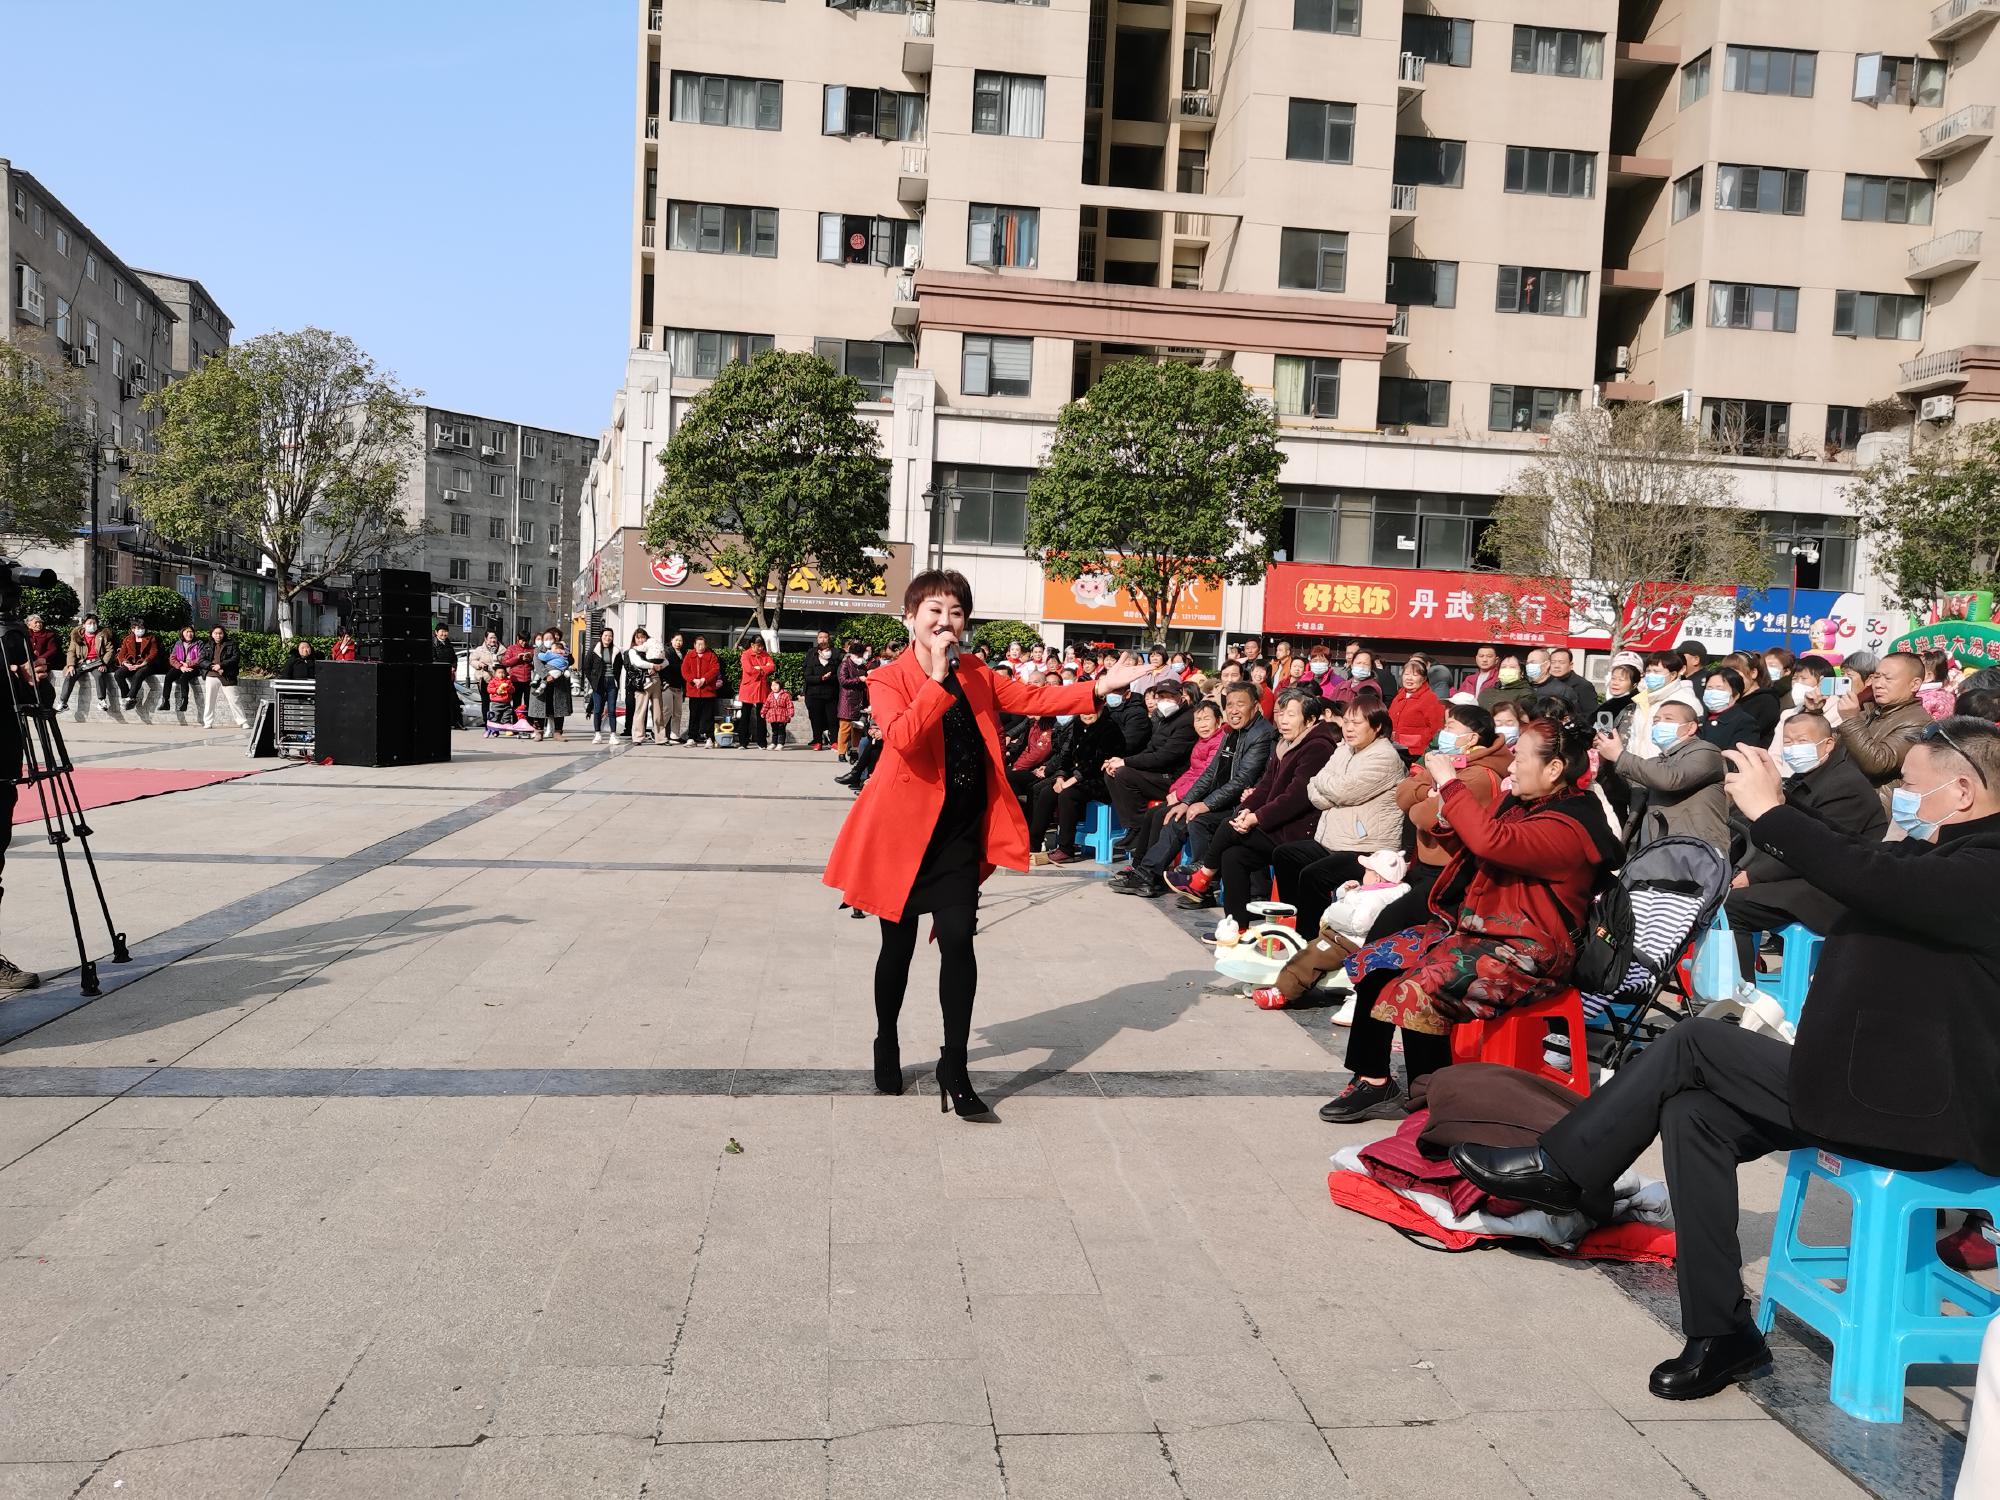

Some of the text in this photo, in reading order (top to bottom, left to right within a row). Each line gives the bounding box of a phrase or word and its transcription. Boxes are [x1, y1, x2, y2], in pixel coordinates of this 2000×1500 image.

[1303, 583, 1547, 625] 好想你 丹武商行
[1685, 626, 1733, 639] 智慧生活馆
[1865, 618, 1887, 635] 5G
